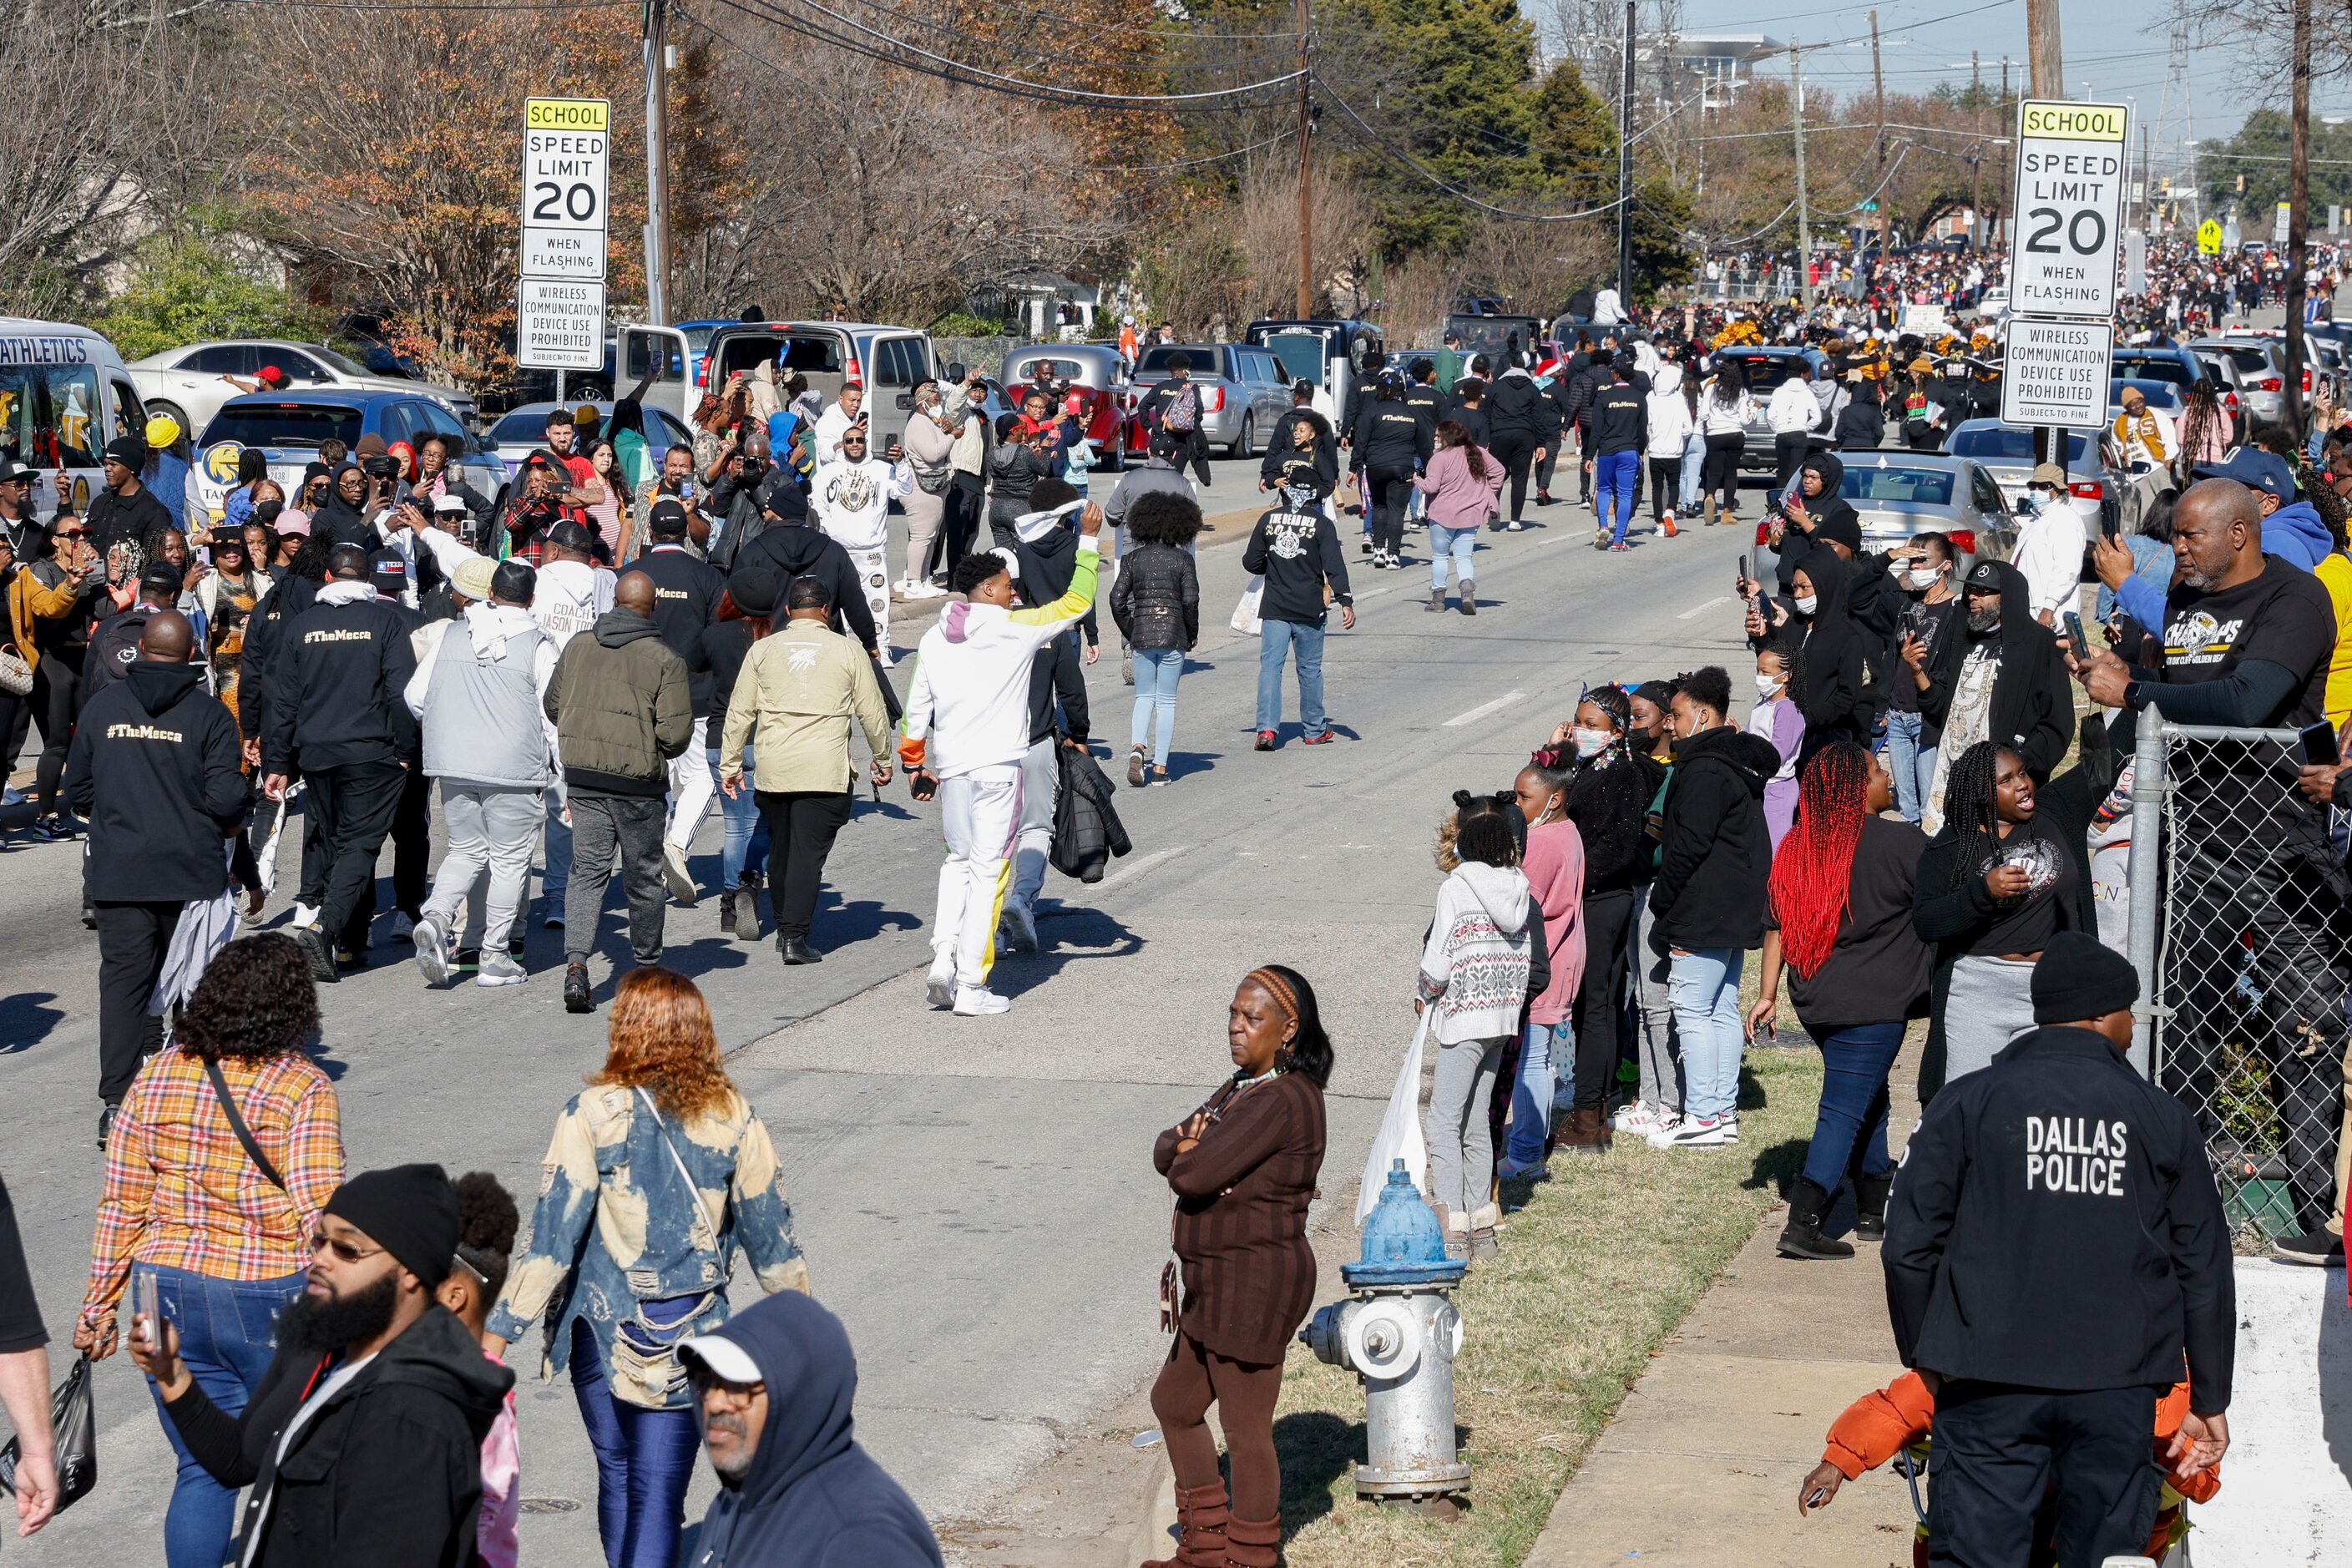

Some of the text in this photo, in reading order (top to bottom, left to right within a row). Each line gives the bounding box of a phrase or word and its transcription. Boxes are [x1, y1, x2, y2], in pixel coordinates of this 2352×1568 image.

[530, 106, 603, 124] SCHOOL
[2028, 111, 2119, 134] SCHOOL
[530, 136, 603, 154] SPEED
[539, 159, 593, 177] LIMIT
[2025, 154, 2117, 175] SPEED
[2035, 180, 2104, 202] LIMIT
[533, 181, 596, 221] 20
[2025, 207, 2106, 255] 20
[547, 238, 581, 250] WHEN
[533, 254, 594, 267] FLASHING
[2042, 266, 2085, 280] WHEN
[539, 286, 587, 300] WIRELESS
[2024, 285, 2100, 301] FLASHING
[525, 301, 600, 316] COMMUNICATION
[533, 317, 590, 331] DEVICE USE
[531, 333, 591, 346] PROHIBITED
[2030, 329, 2089, 345] WIRELESS
[0, 338, 87, 363] ATHLETICS
[2011, 346, 2105, 364] COMMUNICATION
[2021, 366, 2092, 382] DEVICE USE
[2018, 384, 2092, 401] PROHIBITED
[2020, 407, 2089, 419] SUBJECT TO FINE
[1268, 513, 1282, 524] THE
[1282, 513, 1302, 526] BEAR
[554, 603, 590, 620] COACH
[304, 629, 372, 644] #TheMecca
[107, 724, 183, 742] #TheMecca
[2026, 1116, 2127, 1158] DALLAS
[2026, 1154, 2126, 1196] POLICE
